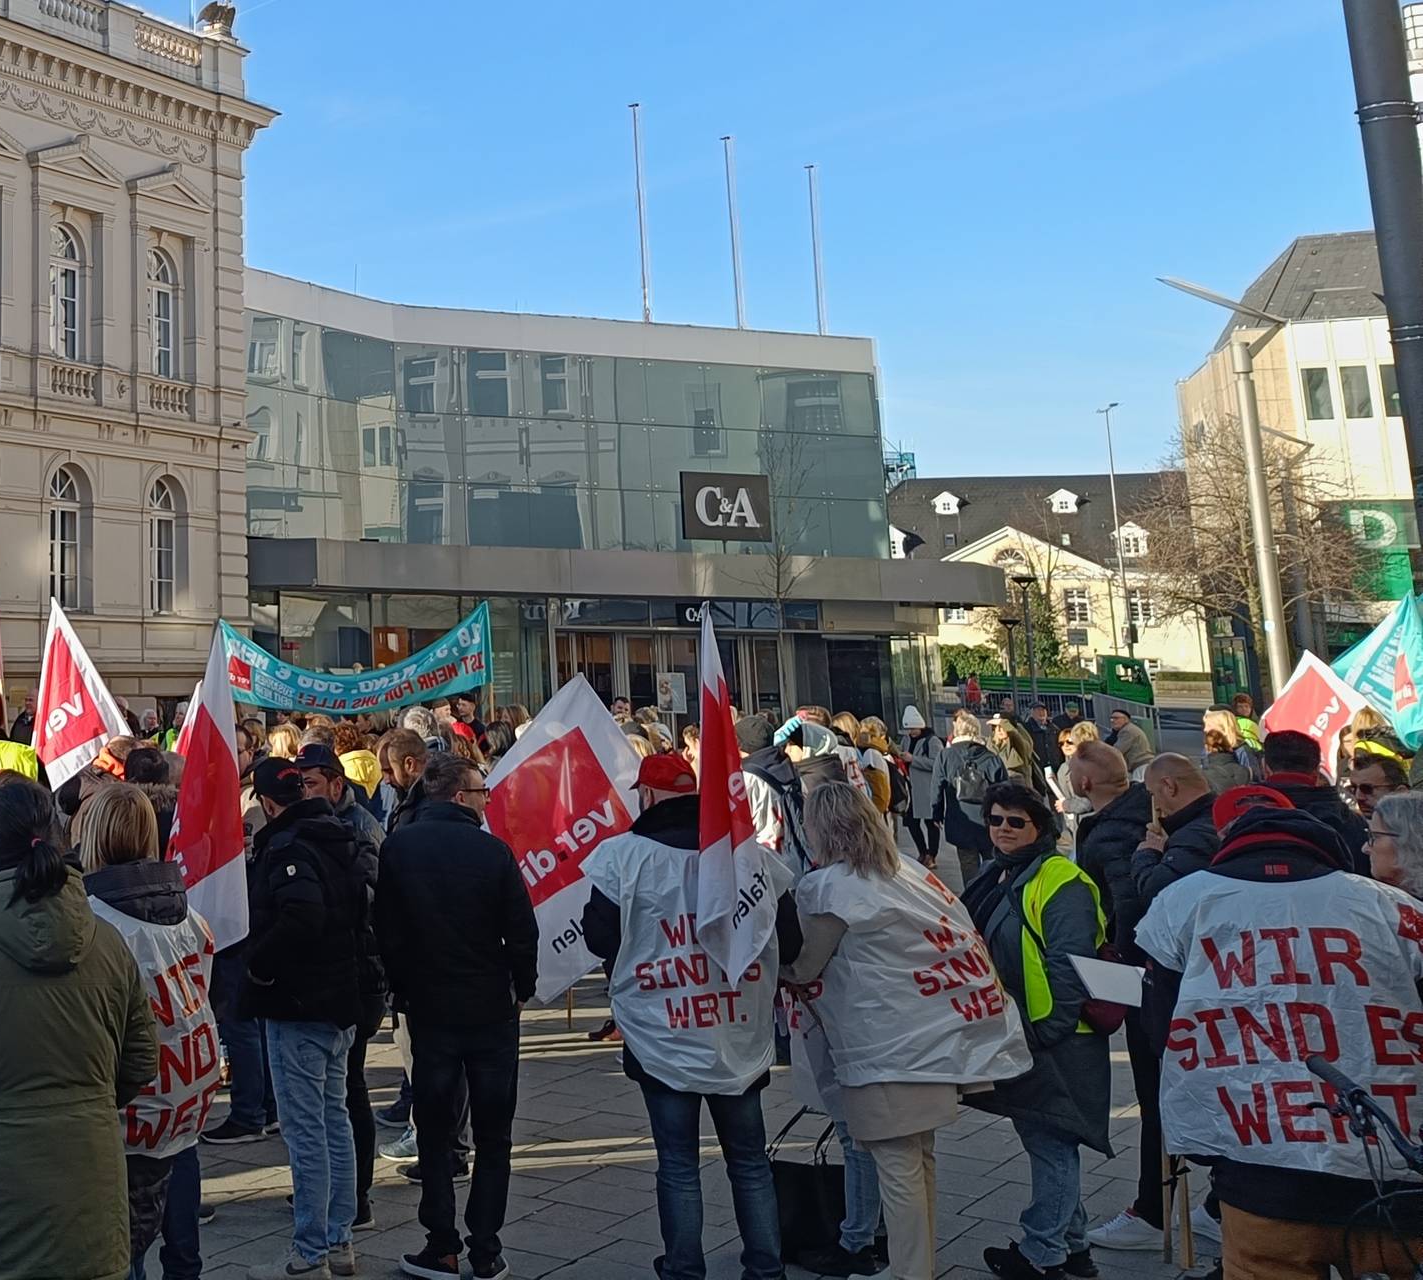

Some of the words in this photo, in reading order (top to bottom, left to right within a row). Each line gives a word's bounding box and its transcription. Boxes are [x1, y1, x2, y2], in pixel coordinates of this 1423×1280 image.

[695, 486, 761, 528] C&A
[637, 952, 709, 991] SIND
[1200, 926, 1370, 990] WIR
[665, 990, 747, 1030] WERT.
[1166, 1001, 1340, 1072] SIND
